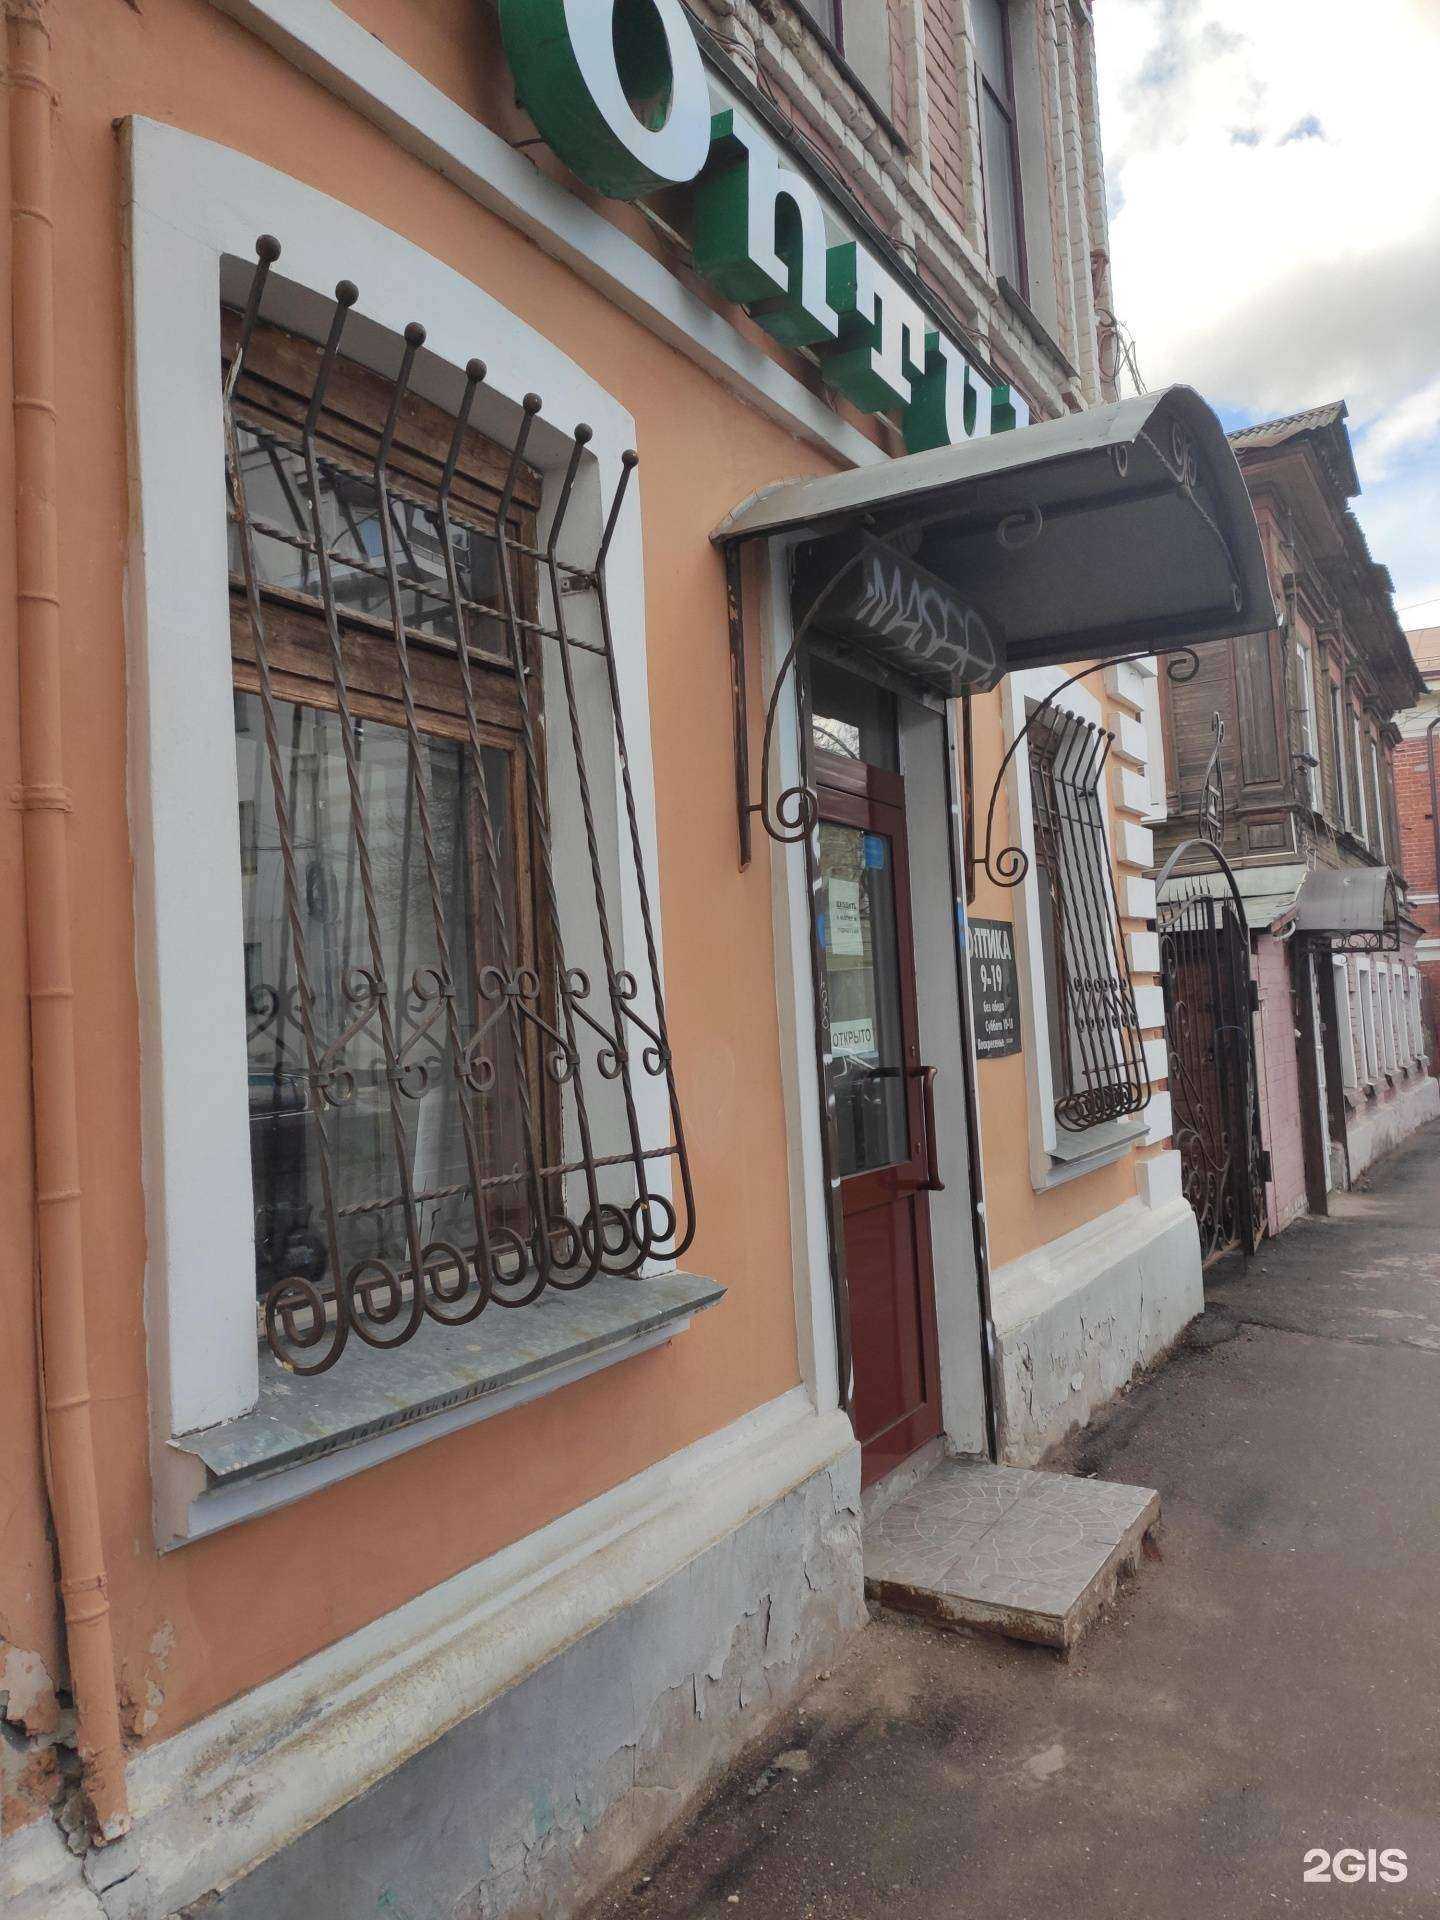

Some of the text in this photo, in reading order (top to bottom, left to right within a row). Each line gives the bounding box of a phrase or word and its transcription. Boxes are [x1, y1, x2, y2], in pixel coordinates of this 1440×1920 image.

[560, 0, 1030, 444] Опти
[980, 964, 1003, 992] 9-19
[832, 1028, 872, 1047] ОТКРЫТО
